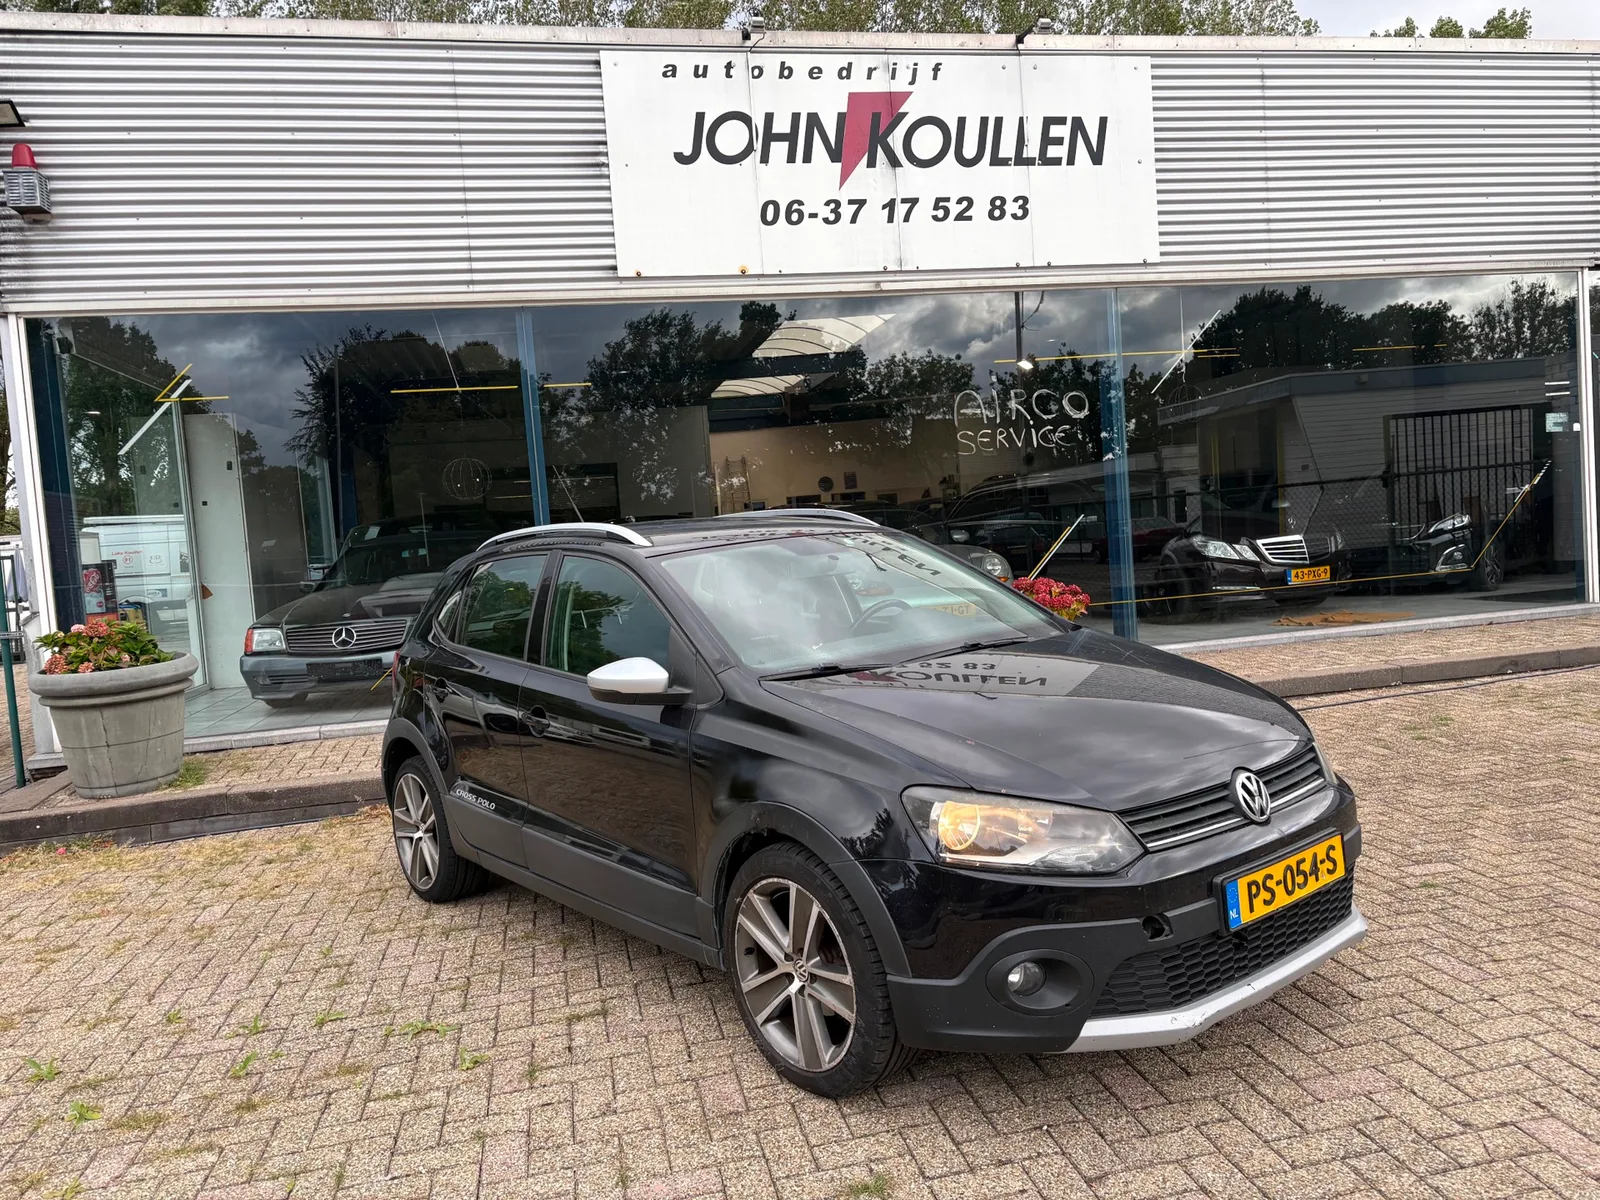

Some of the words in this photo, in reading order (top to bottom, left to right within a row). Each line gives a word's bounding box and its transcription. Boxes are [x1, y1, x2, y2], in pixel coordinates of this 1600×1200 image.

[662, 61, 942, 86] autobedrijf
[673, 111, 848, 165] JOHN
[866, 112, 1108, 168] KOULLEN
[760, 198, 867, 226] 06-37
[880, 197, 920, 224] 17
[931, 196, 974, 222] 52
[987, 195, 1030, 221] 83
[954, 376, 1090, 427] AIRCO
[956, 420, 1077, 455] SERVICE
[1294, 568, 1328, 580] 43-PXG-9
[456, 788, 477, 802] CROSS
[477, 797, 496, 810] POLO
[1247, 844, 1338, 914] PS-054-S
[1229, 908, 1239, 920] NL
